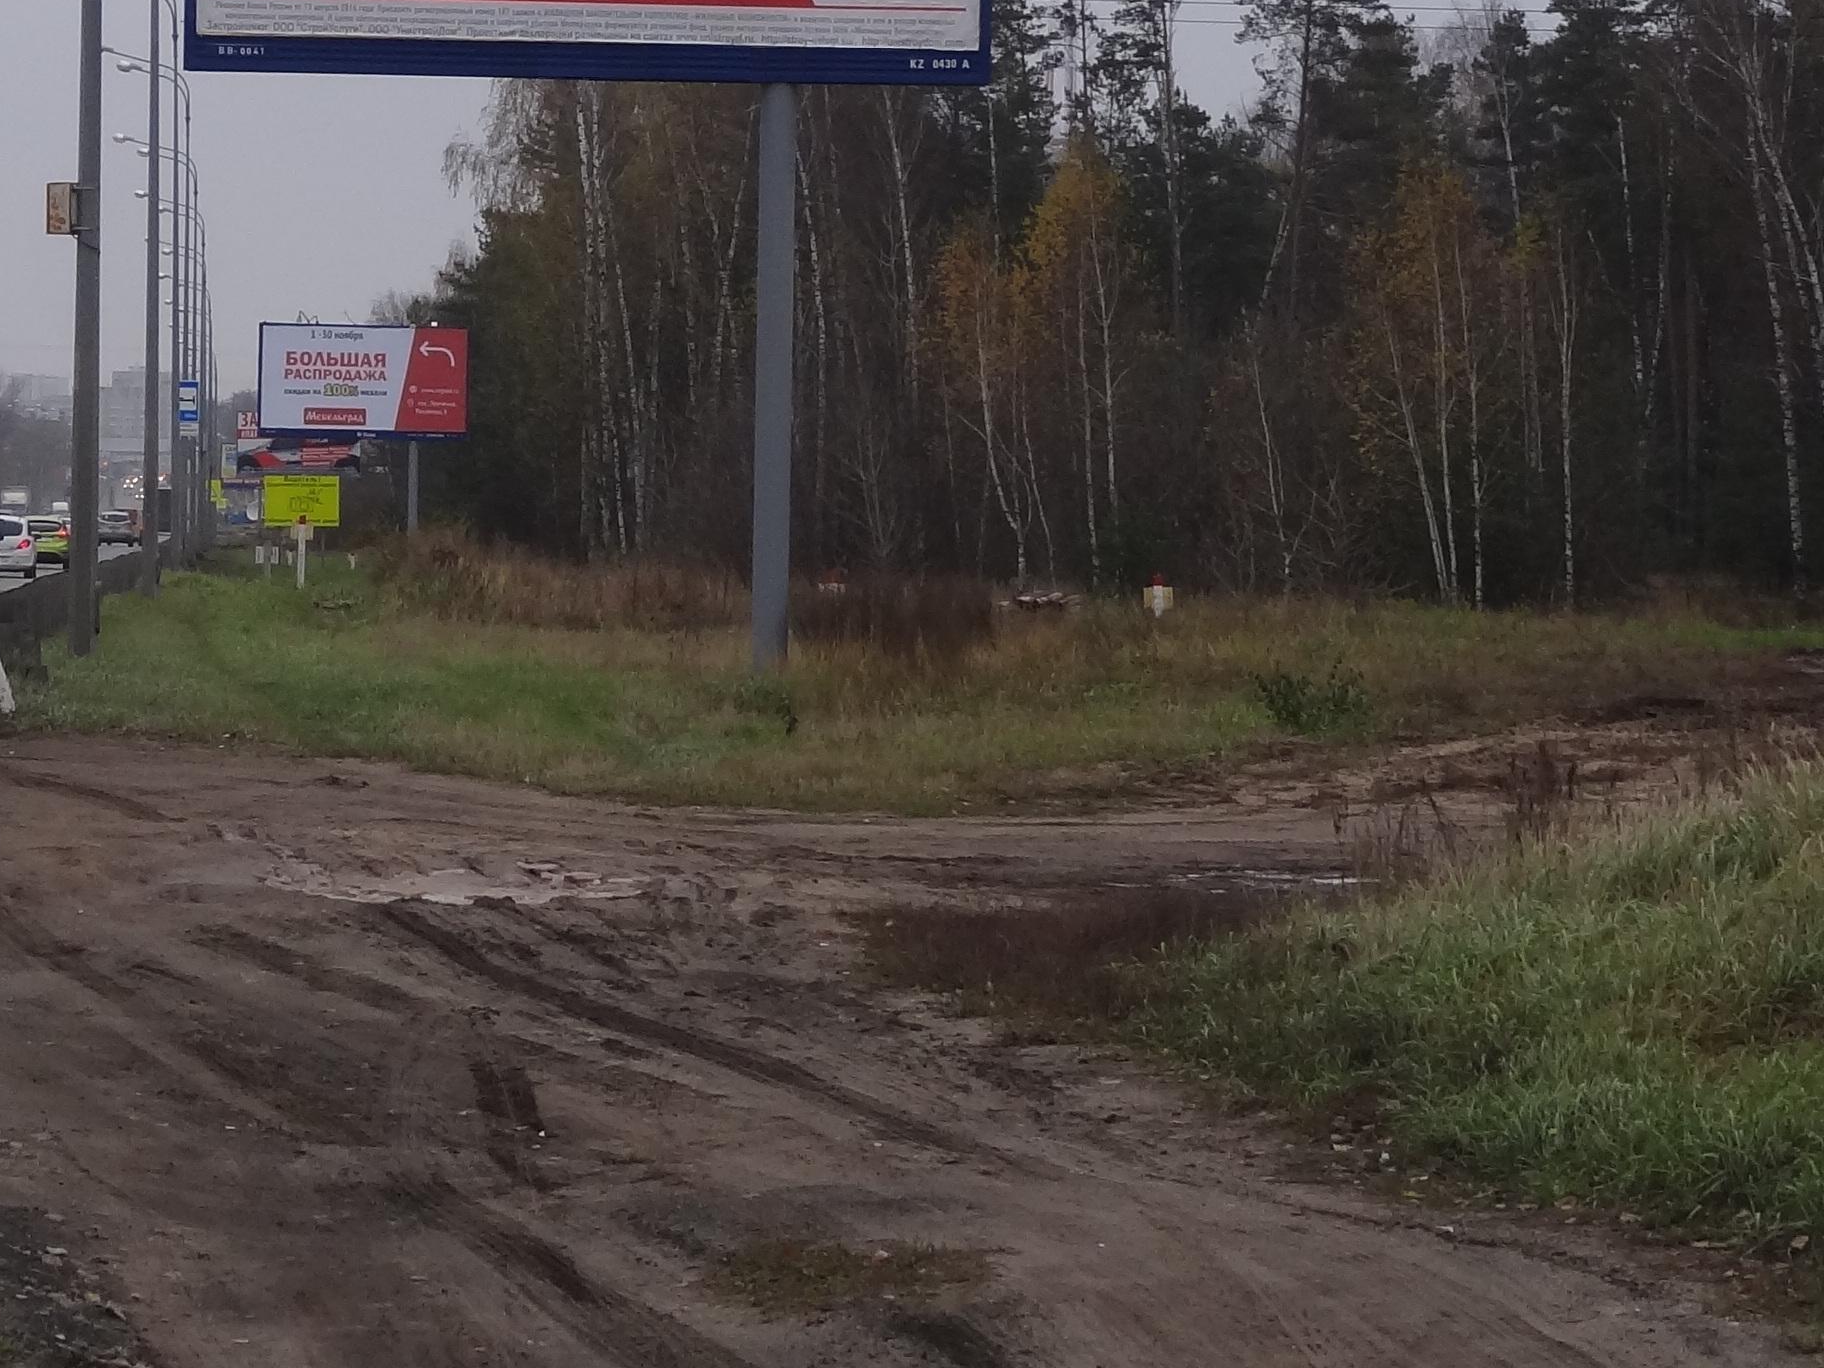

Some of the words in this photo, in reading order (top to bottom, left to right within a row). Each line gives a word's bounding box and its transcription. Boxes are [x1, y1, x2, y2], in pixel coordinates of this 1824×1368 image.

[909, 59, 925, 70] KZ
[932, 59, 957, 70] 0430
[962, 59, 970, 70] A
[285, 351, 387, 368] БОЛЬШАЯ
[283, 368, 387, 383] РАСПРОДАЖА
[323, 383, 359, 397] 100%
